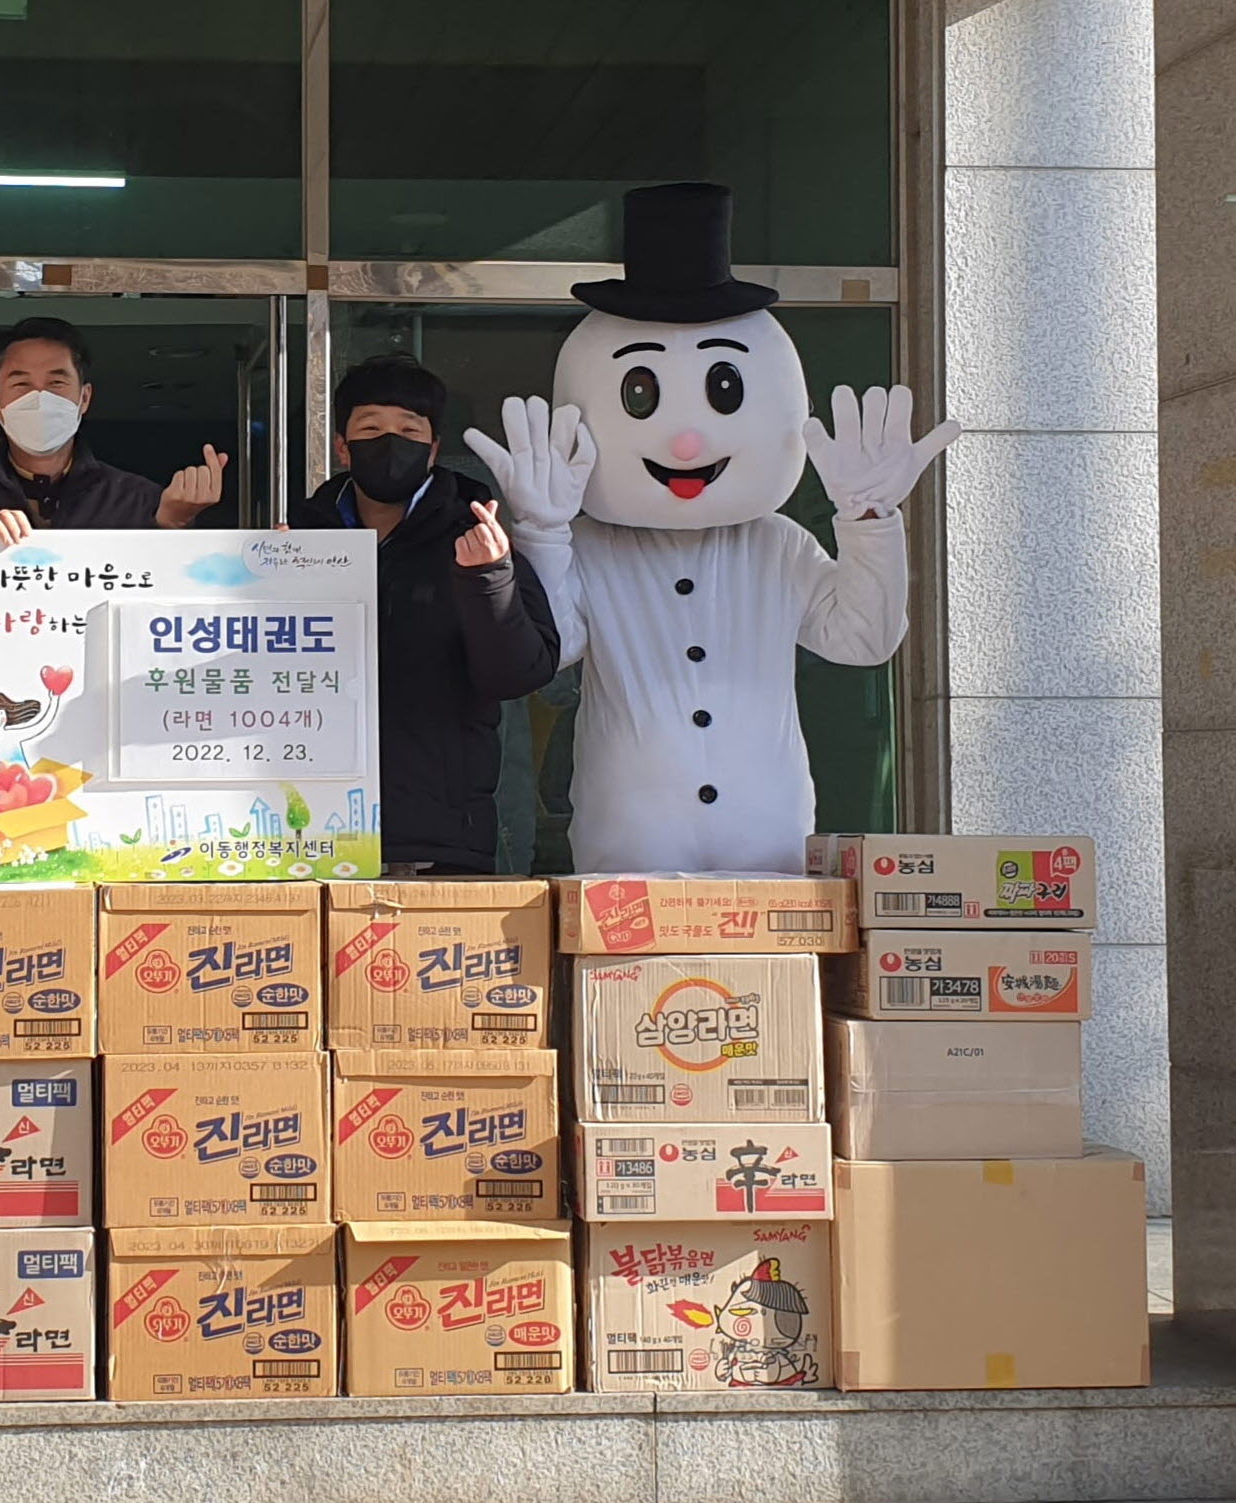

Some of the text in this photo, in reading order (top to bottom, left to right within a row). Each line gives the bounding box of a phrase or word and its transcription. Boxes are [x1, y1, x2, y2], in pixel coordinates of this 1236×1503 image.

[68, 563, 154, 591] 마음으로
[149, 616, 336, 654] 인성태권도
[144, 667, 340, 695] 후원물품 전달식
[163, 708, 324, 732] (라면 1004개)
[172, 744, 314, 763] 2022. 12. 23.
[198, 838, 334, 861] 이동행정복지센터
[898, 860, 934, 875] 농심
[998, 881, 1068, 905] 짜파구리
[682, 924, 713, 938] 국물도
[186, 941, 293, 993] 진라면
[417, 942, 522, 993] 진라면
[903, 955, 942, 973] 농심
[143, 969, 173, 984] 오뚜기
[373, 968, 403, 983] 오뚜기
[260, 987, 304, 1003] 순한맛
[932, 979, 980, 994] 가3478
[31, 992, 78, 1010] 순한맛
[490, 988, 532, 1003] 순한맛
[634, 1004, 759, 1048] 삼양라면
[720, 1041, 759, 1058] 매운맛
[17, 1082, 72, 1104] 멀티팩
[18, 1120, 31, 1135] 신
[419, 1107, 527, 1159] 진라면
[194, 1111, 302, 1164] 진라면
[376, 1134, 406, 1149] 오뚜기
[494, 1154, 538, 1170] 순한맛
[681, 1147, 717, 1161] 농심
[11, 1157, 68, 1180] 라면
[268, 1157, 312, 1174] 순한맛
[616, 1161, 653, 1175] 가3486
[725, 1139, 782, 1213] 辛
[780, 1173, 817, 1187] 라면
[752, 1229, 807, 1244] SAMYANG
[23, 1253, 78, 1275] 멀티팩
[609, 1243, 715, 1287] 불닭볶음면
[23, 1292, 35, 1306] 신
[436, 1277, 546, 1332] 진라면
[196, 1287, 305, 1340] 진라면
[393, 1305, 425, 1320] 오뚜기
[16, 1328, 72, 1352] 라면
[272, 1333, 317, 1349] 순한맛
[513, 1325, 558, 1342] 매운맛
[606, 1332, 637, 1345] 멀티팩
[285, 1383, 309, 1392] 225
